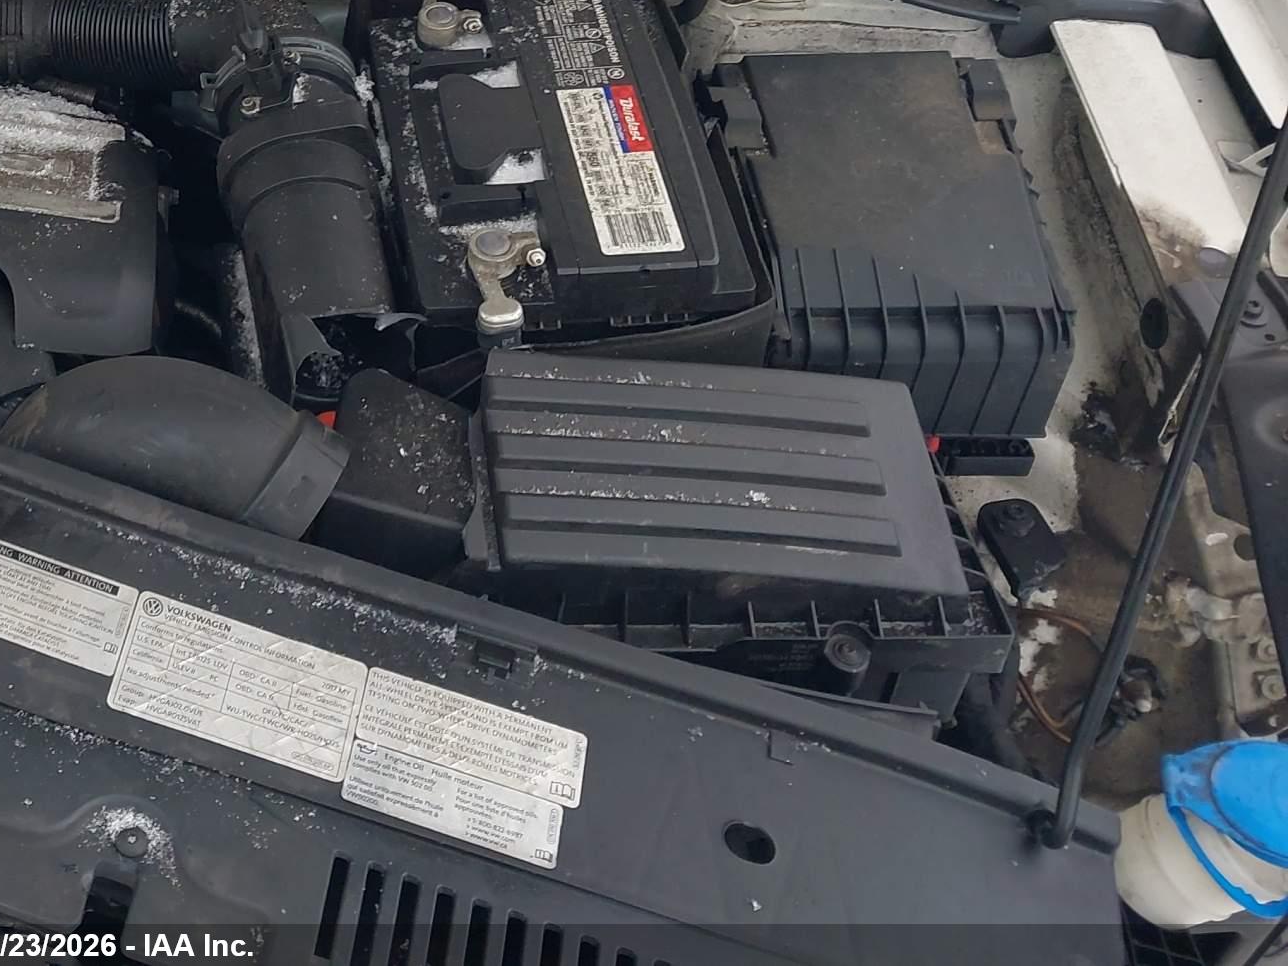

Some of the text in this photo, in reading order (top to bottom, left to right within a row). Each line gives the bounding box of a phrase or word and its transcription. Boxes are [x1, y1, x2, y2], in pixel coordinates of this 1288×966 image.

[618, 98, 646, 142] Duralast
[16, 553, 60, 574] WARNING
[63, 569, 113, 593] ATTENTION
[166, 604, 232, 633] VOLKSWAGEN
[371, 671, 389, 682] THIS
[390, 677, 421, 692] VEHICLE
[367, 689, 401, 705] TESTING
[366, 758, 381, 768] only
[384, 752, 483, 791] Engine Oil Huile moteur
[397, 776, 409, 784] VW
